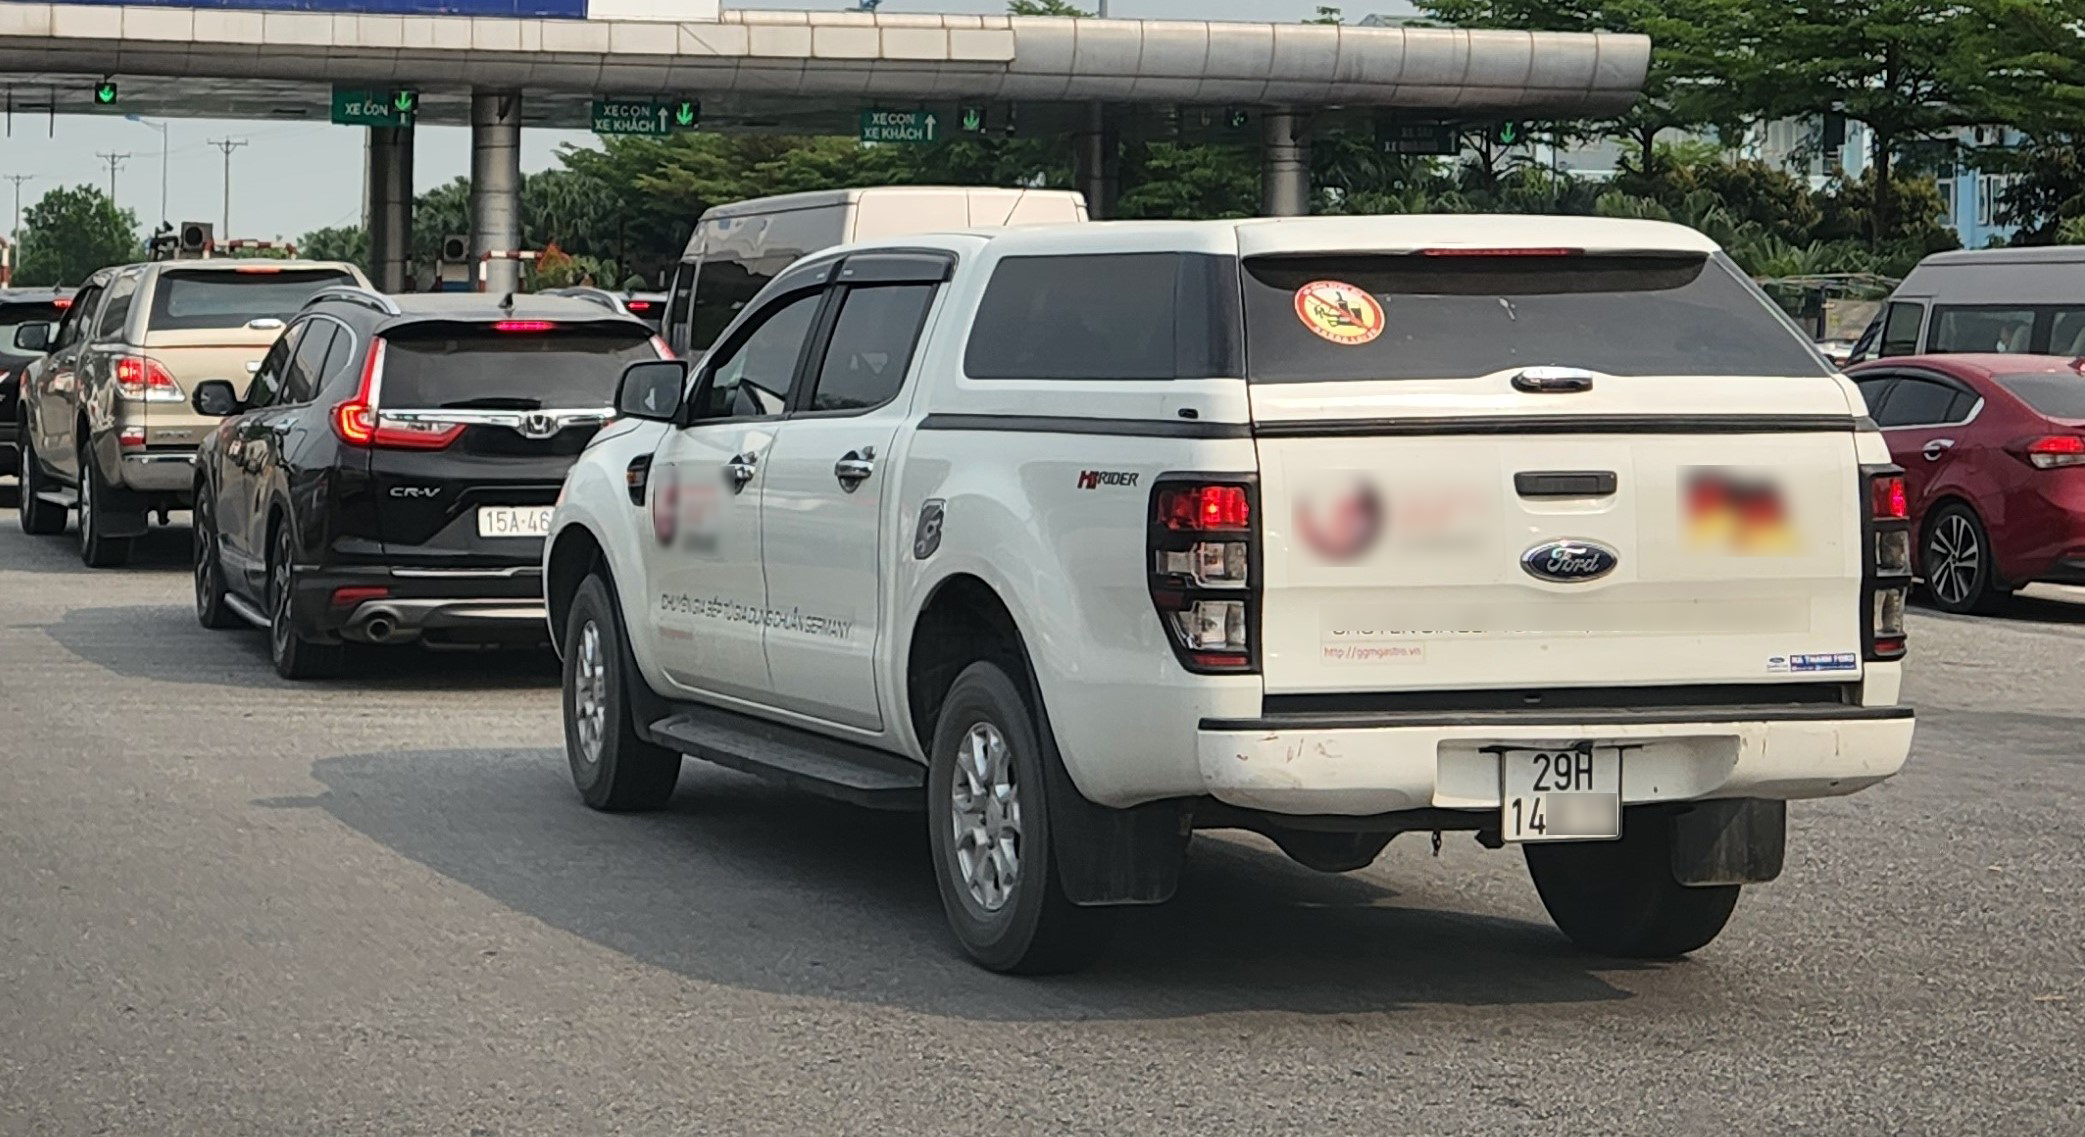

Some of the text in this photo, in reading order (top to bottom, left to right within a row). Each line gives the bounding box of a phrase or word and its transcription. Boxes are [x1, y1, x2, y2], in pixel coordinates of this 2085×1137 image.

[345, 103, 361, 115] XE
[595, 119, 611, 131] XE
[864, 127, 880, 139] XE
[390, 487, 440, 497] CR-V
[1547, 547, 1600, 573] Ford
[1533, 753, 1593, 791] 29H
